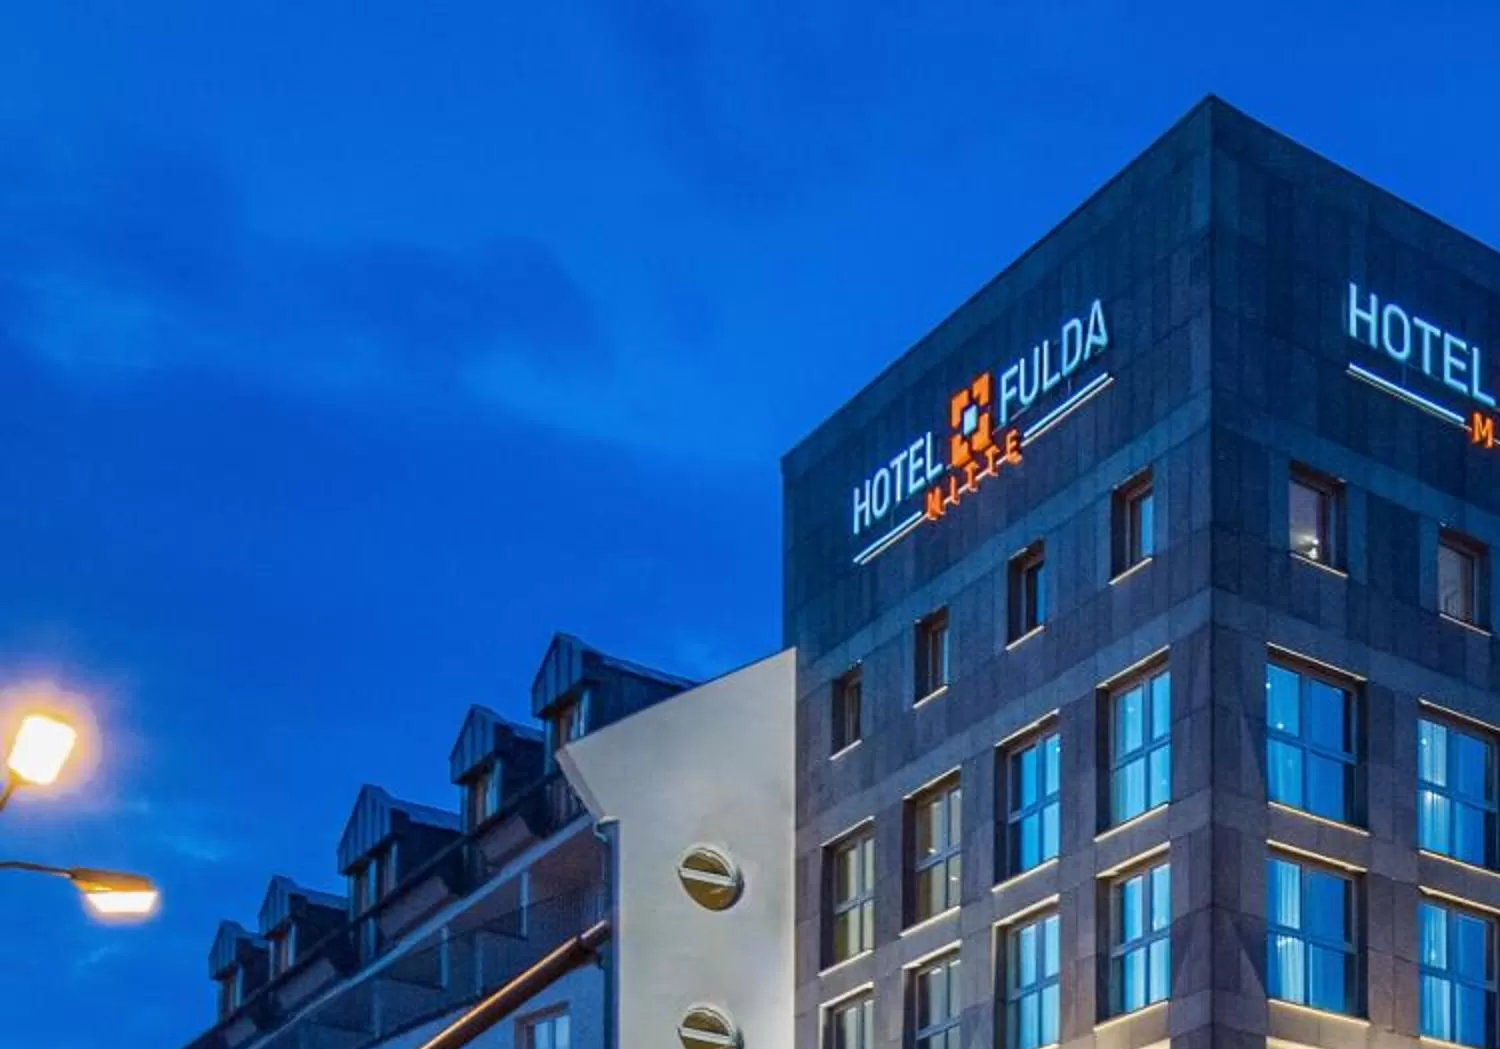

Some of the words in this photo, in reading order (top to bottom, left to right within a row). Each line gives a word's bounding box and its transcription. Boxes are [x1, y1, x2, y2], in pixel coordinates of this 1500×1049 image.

[1349, 282, 1496, 406] HOTEL
[853, 431, 943, 535] HOTEL
[999, 299, 1109, 426] FULDA
[926, 429, 1023, 521] MITTE
